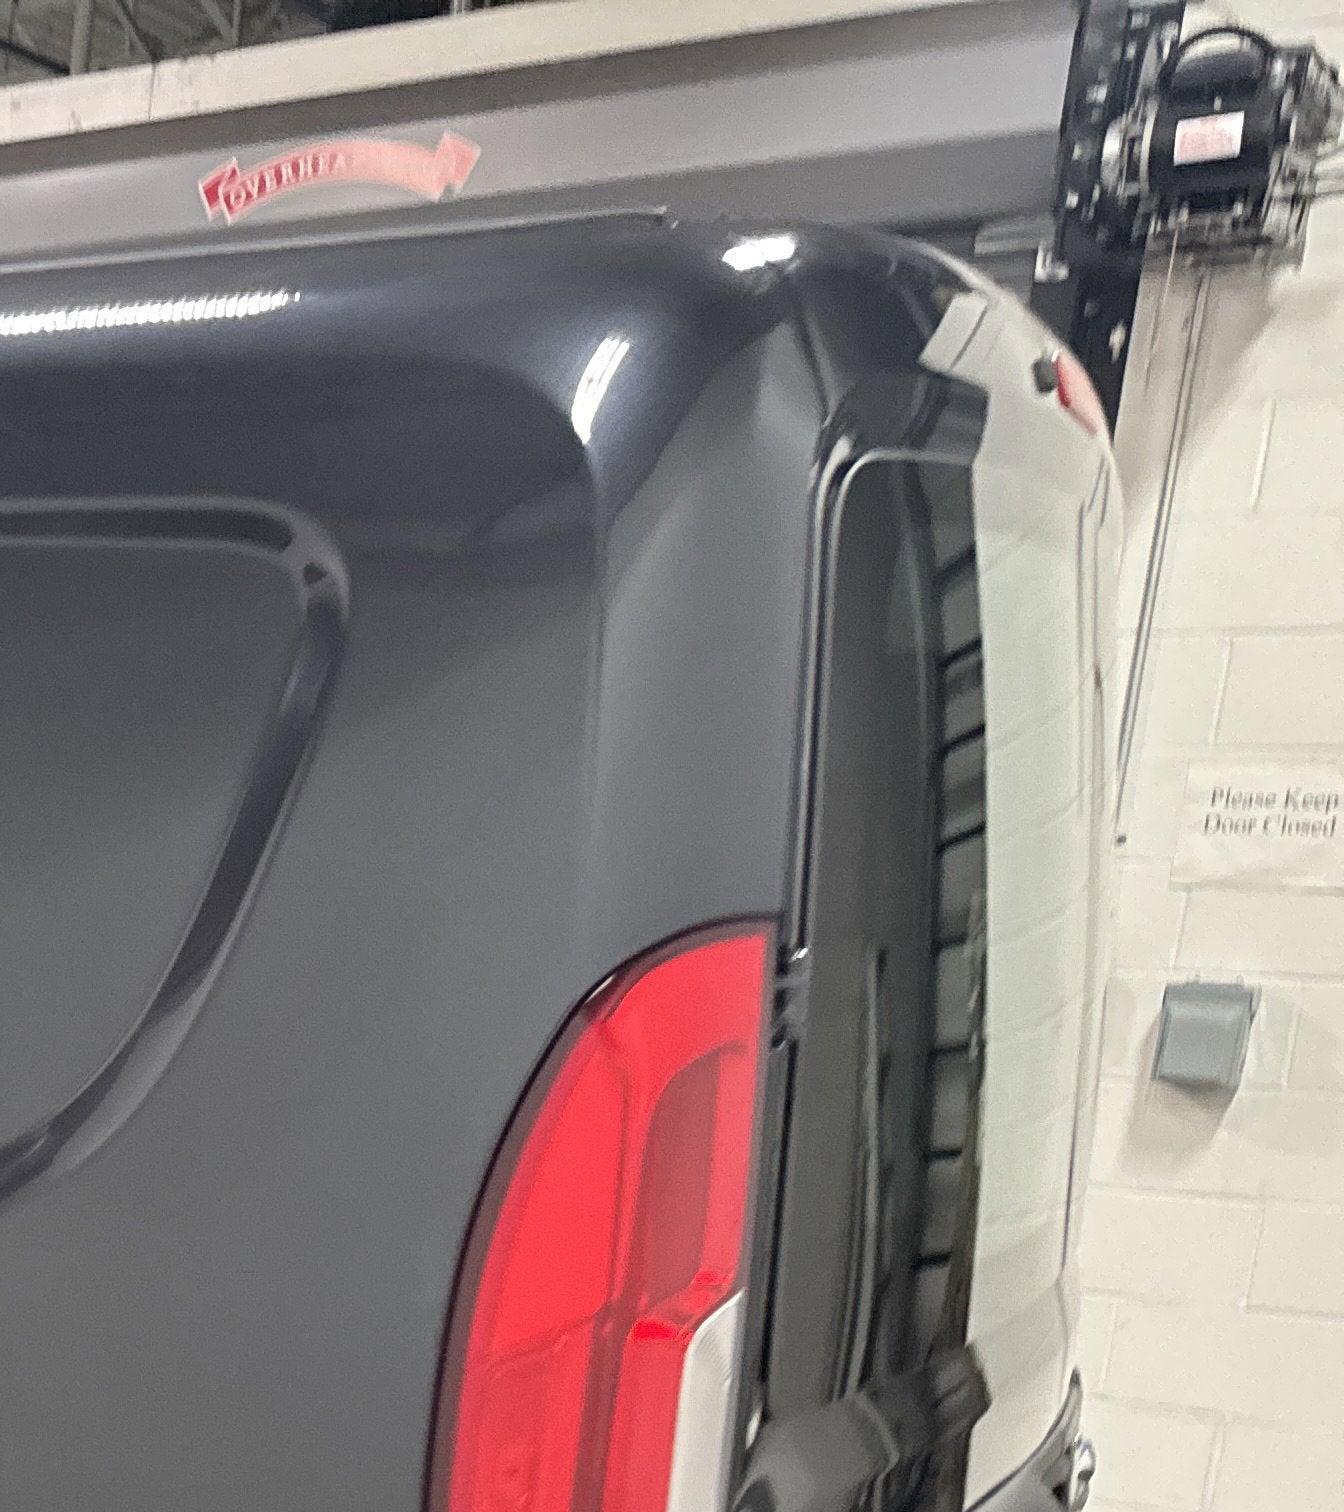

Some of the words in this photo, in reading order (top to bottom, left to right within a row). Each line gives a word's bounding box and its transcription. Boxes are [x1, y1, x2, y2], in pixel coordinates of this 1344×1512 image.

[1211, 786, 1277, 810] Please
[1284, 787, 1340, 815] Keep
[1204, 811, 1257, 836] Door
[1263, 813, 1337, 838] Closed
